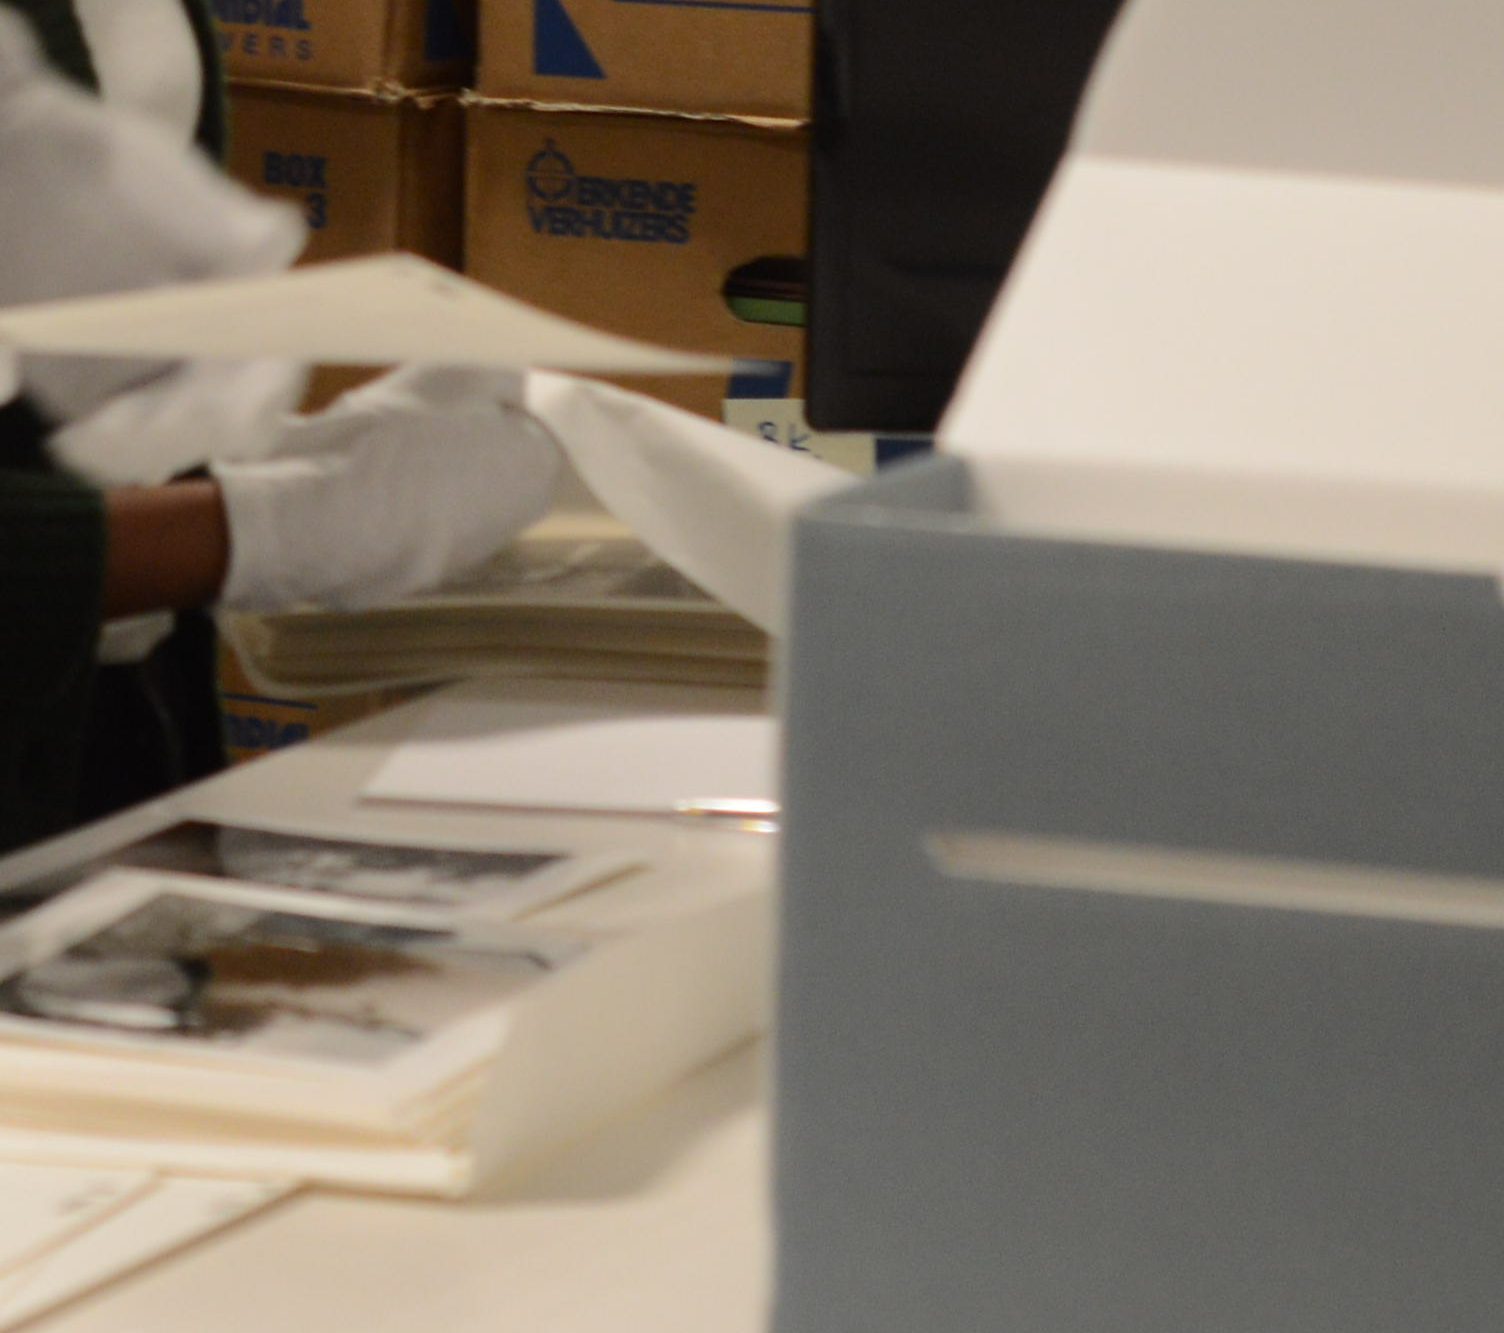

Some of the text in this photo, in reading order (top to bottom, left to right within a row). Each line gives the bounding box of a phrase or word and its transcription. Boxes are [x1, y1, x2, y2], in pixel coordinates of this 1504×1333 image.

[263, 149, 329, 189] BOX
[304, 191, 328, 229] 3
[575, 175, 697, 214] ERKENDE
[529, 205, 690, 245] VERHUIZERS
